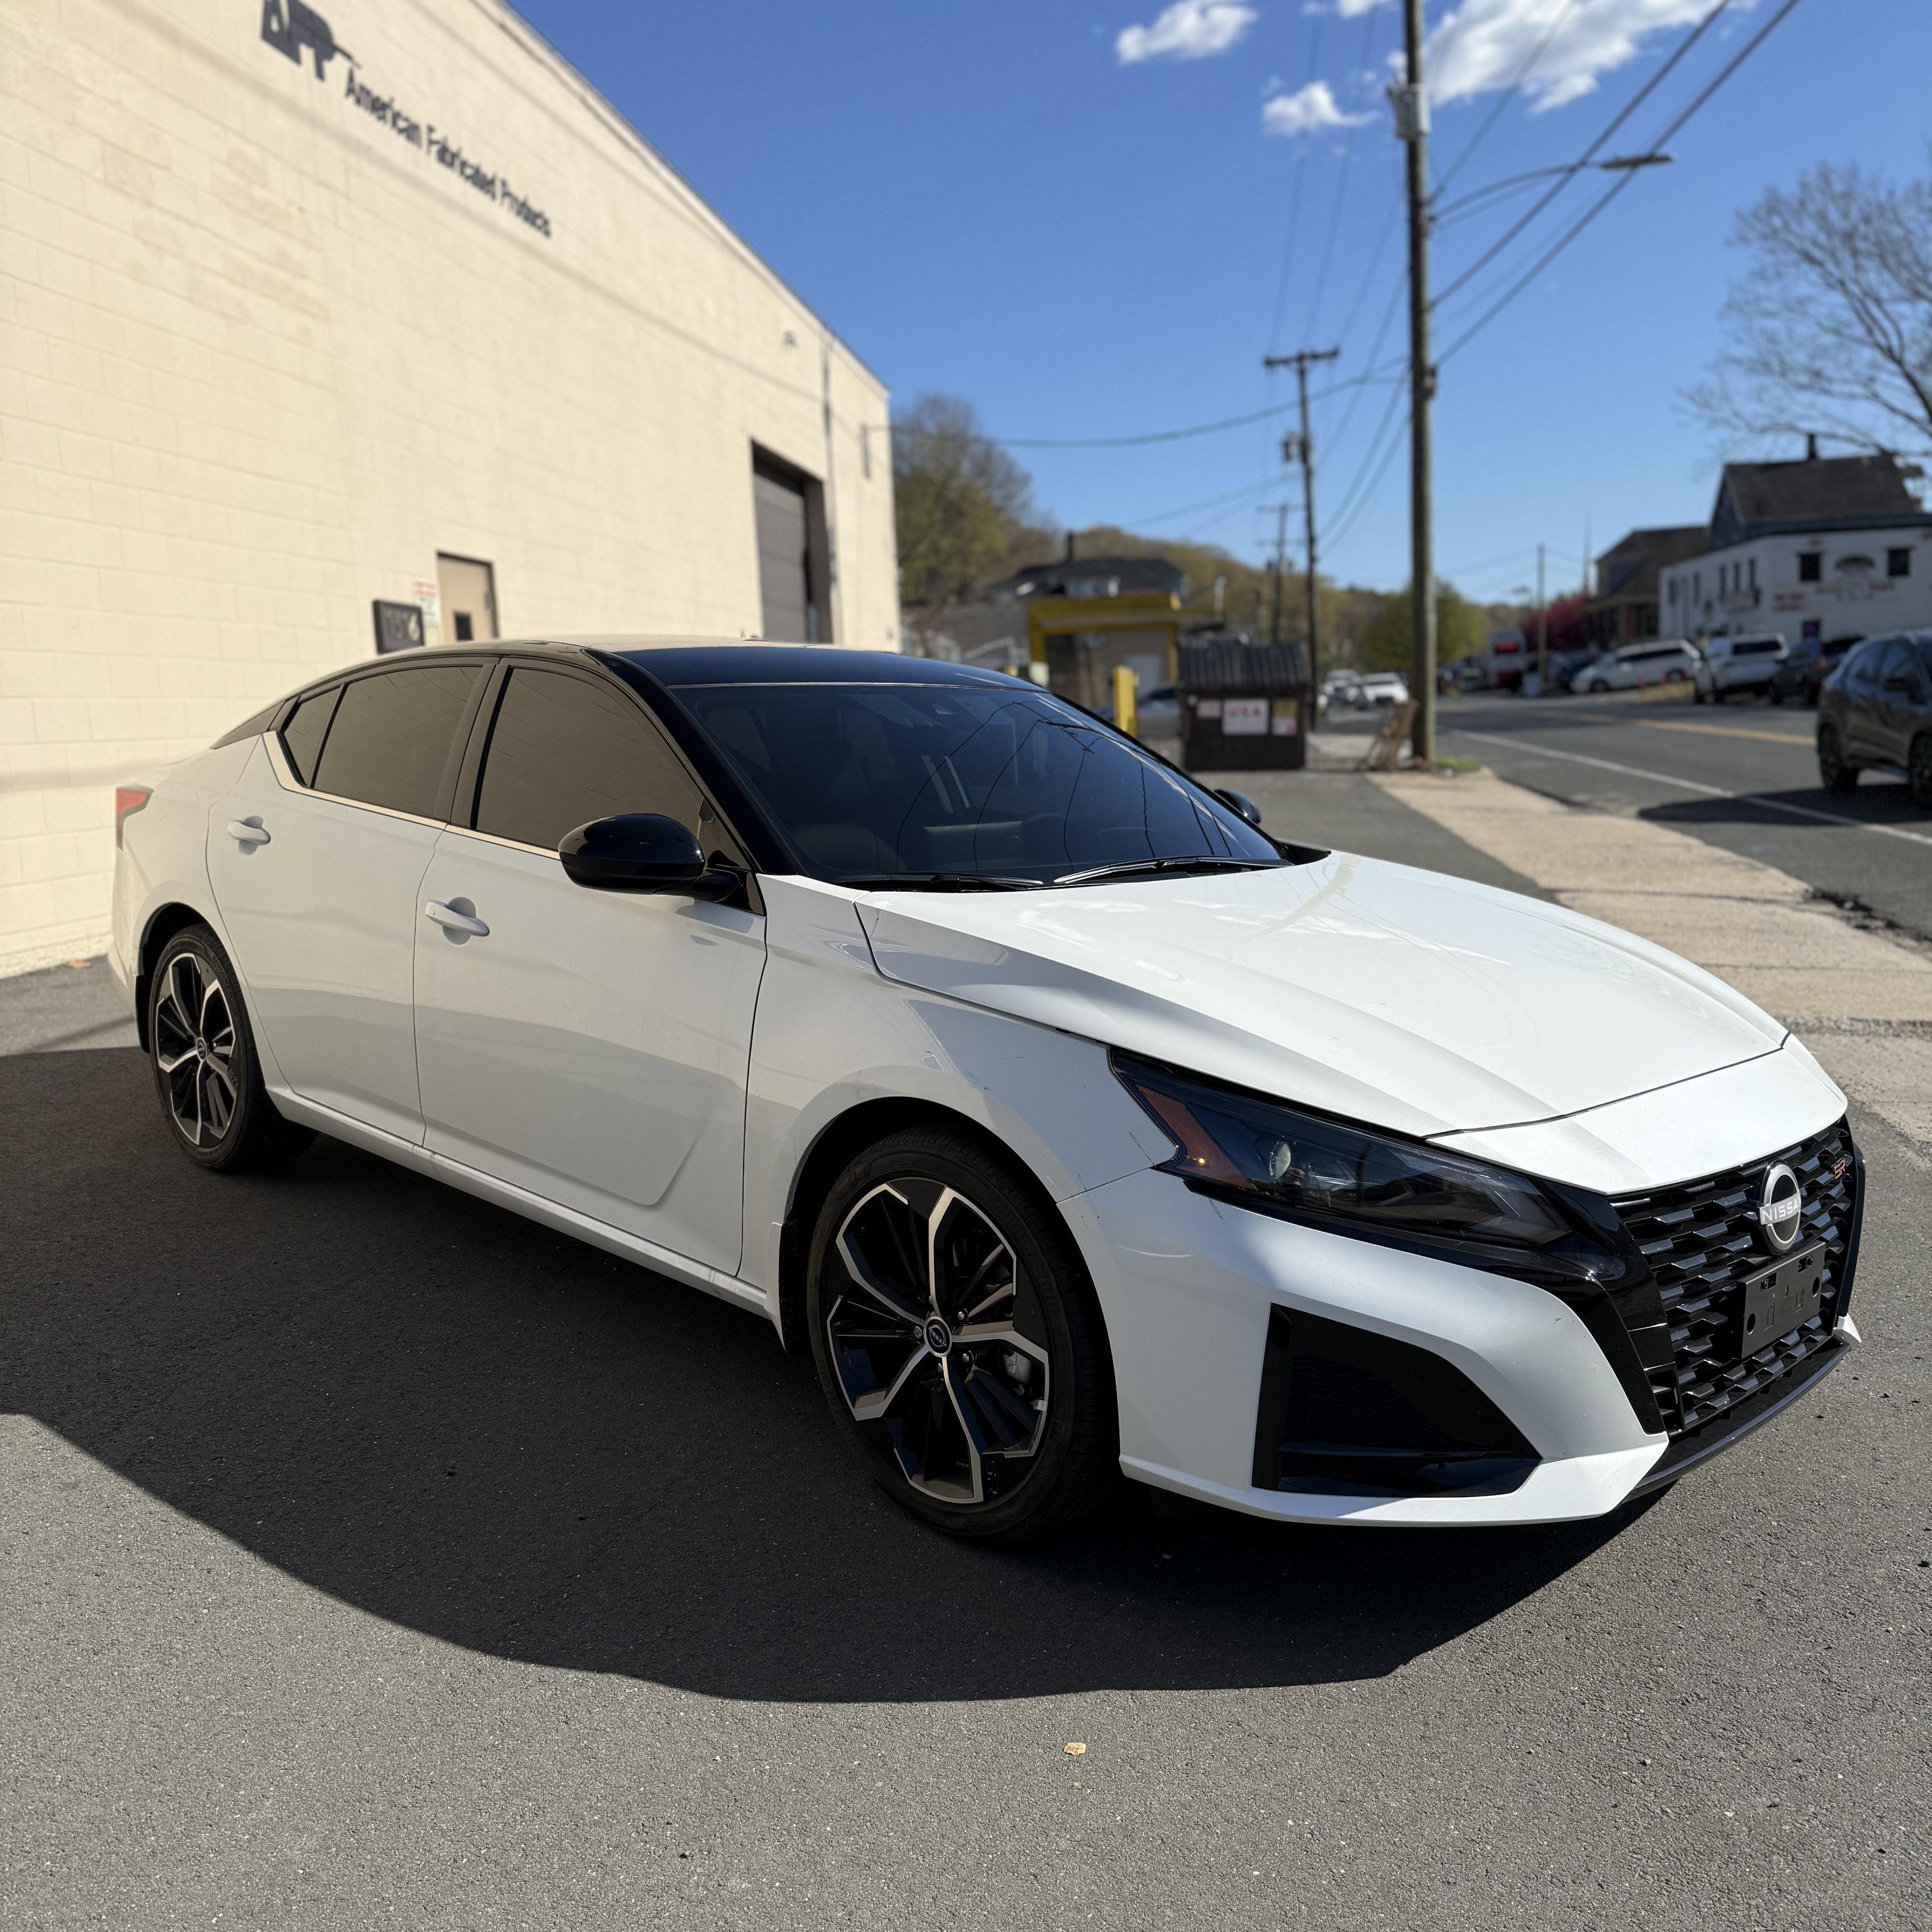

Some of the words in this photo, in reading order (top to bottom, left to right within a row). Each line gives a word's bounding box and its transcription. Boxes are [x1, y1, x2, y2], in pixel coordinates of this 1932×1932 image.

[345, 66, 423, 149] American
[426, 123, 497, 201] Fabricated
[500, 177, 551, 237] Products
[1833, 1159, 1846, 1180] SR
[995, 1201, 1062, 1320] BRIDGESTONE
